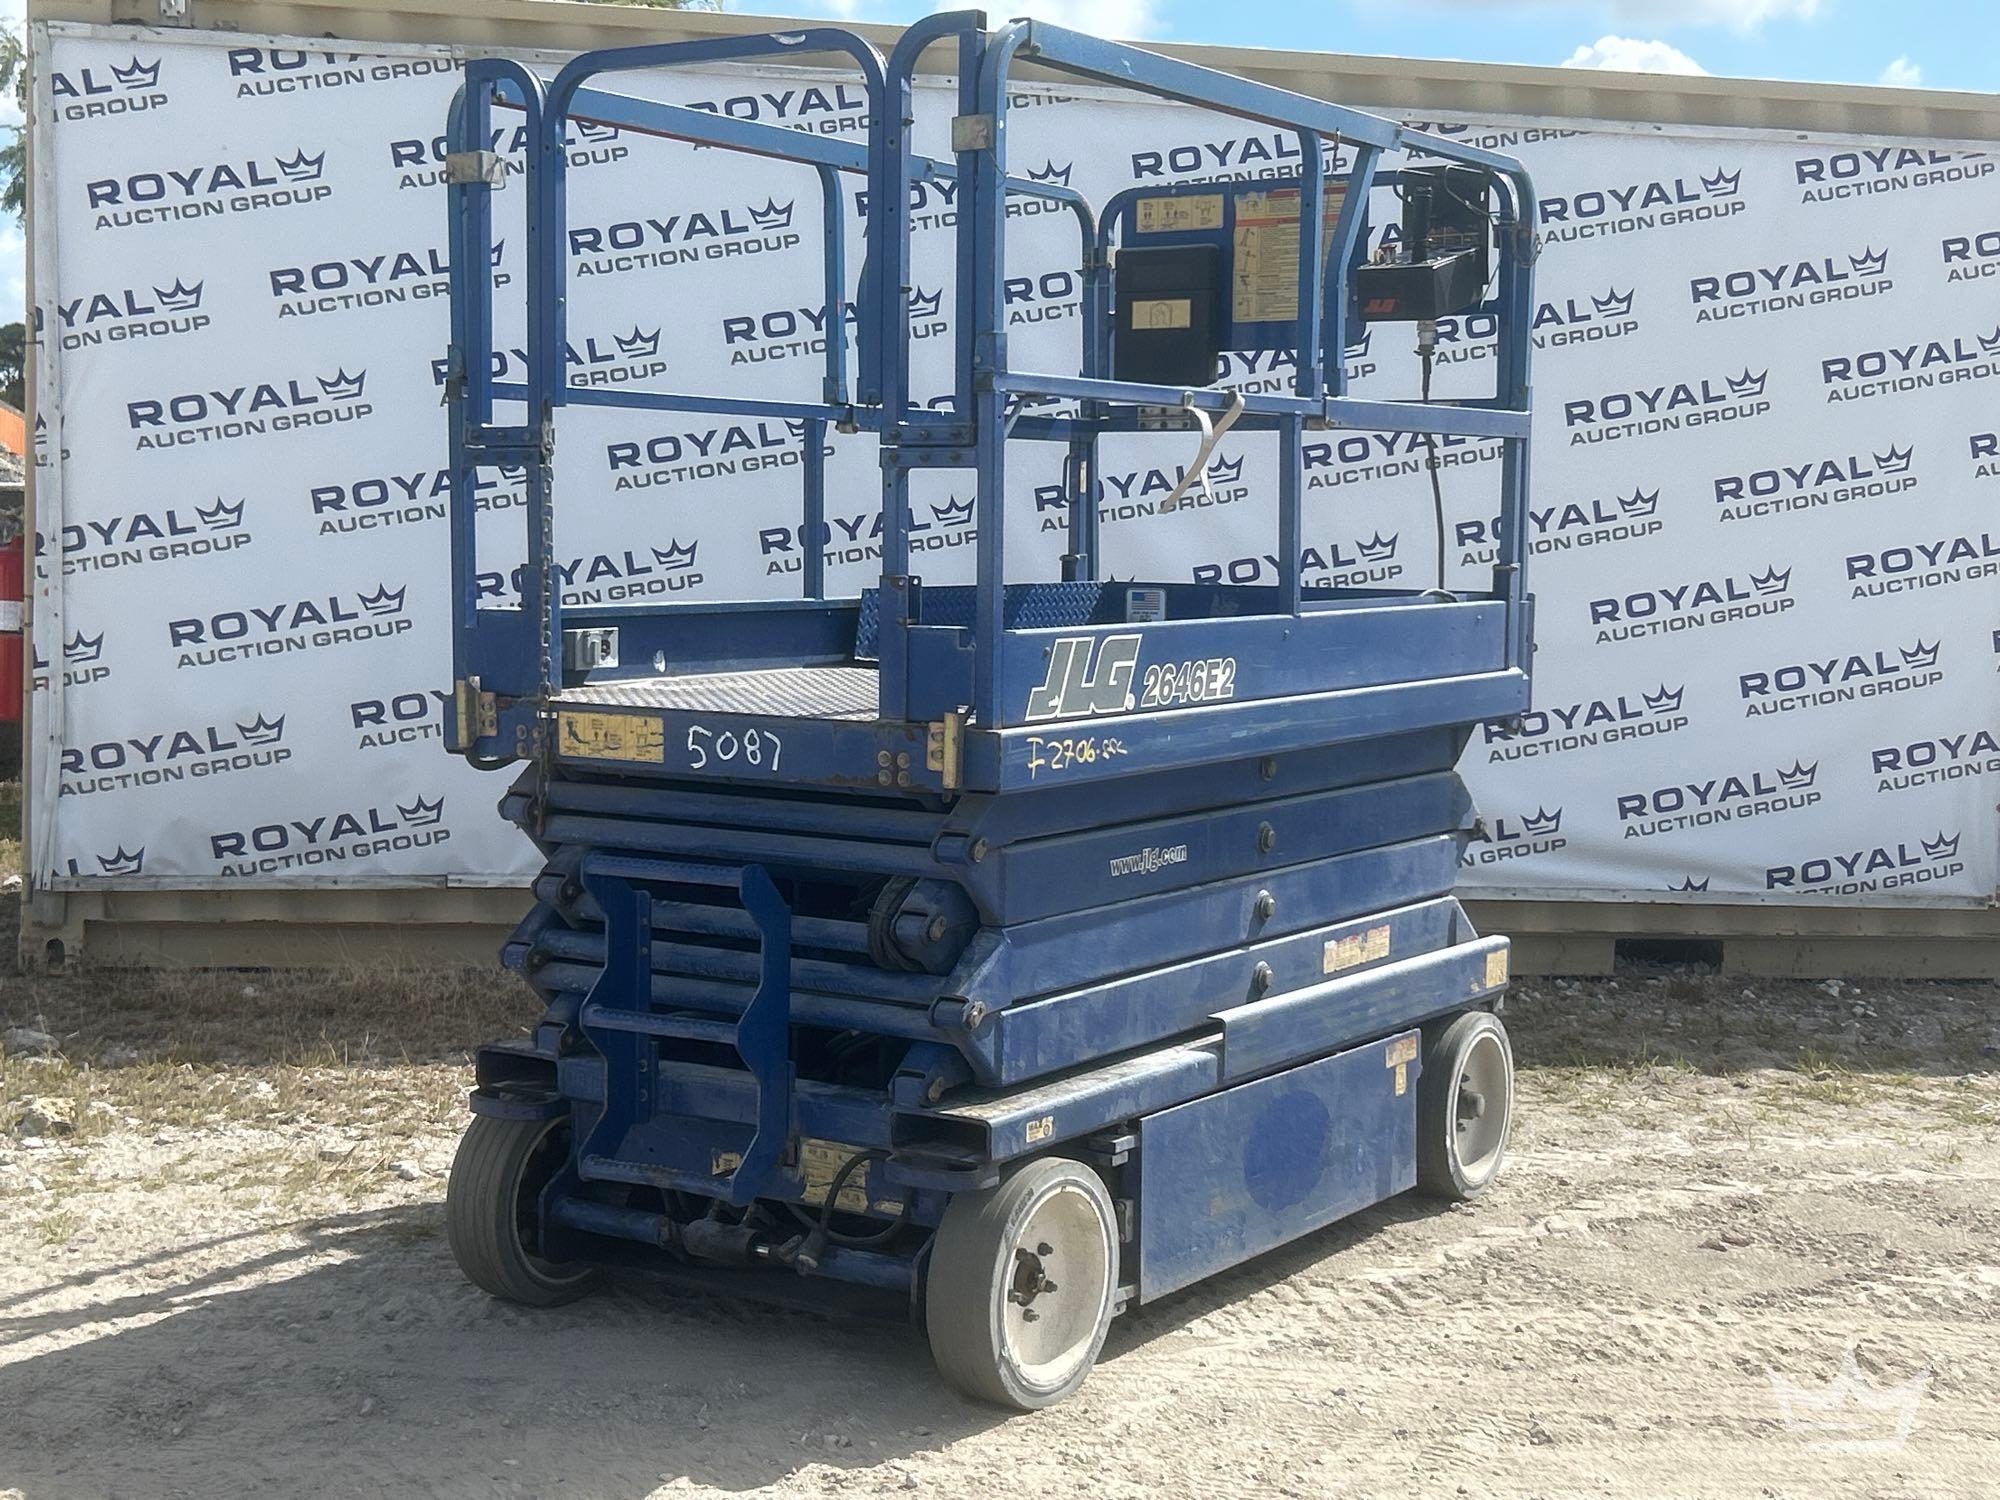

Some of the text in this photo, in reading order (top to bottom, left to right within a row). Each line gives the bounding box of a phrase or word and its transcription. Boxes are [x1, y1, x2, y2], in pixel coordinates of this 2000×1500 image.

[237, 69, 365, 98] AUCTION
[65, 94, 169, 121] GROUP
[566, 146, 631, 168] OUP
[1130, 134, 1302, 179] ROYAL
[1796, 141, 1952, 185] ROYAL
[85, 161, 278, 209] ROYAL
[1538, 179, 1701, 225] ROYAL
[1802, 163, 1995, 204] AUCTION GROUP
[94, 186, 332, 230] AUCTION GROUP
[1545, 201, 1746, 244] AUCTION GROUP
[569, 210, 750, 256] ROYAL
[577, 234, 800, 277] AUCTION GROUP
[270, 249, 454, 297] ROYAL
[279, 273, 511, 318] AUCTION GRP
[1690, 258, 1849, 304] ROYAL
[31, 290, 156, 329] YAL
[1429, 300, 1592, 346] ROAL
[1696, 280, 1893, 323] AUCTION GROUP
[108, 315, 211, 342] GROUP
[1435, 321, 1638, 366] AUCTN GROUP
[570, 362, 668, 388] GROUP
[730, 339, 828, 366] AUCTIO
[1822, 338, 1978, 384] ROYAL
[128, 380, 319, 430] ROYAL
[1565, 380, 1726, 427] ROYAL
[1828, 362, 2000, 403] AUCTION GROU
[137, 404, 373, 451] AUCTION GROUP
[607, 423, 786, 471] ROYAL
[1571, 401, 1771, 447] AUCTION GROUP
[615, 446, 836, 491] AUCTION GROP
[1031, 465, 1203, 513] RYAL
[1308, 459, 1420, 490] AUCTION
[1714, 457, 1873, 503] ROYAL
[320, 491, 530, 536] AUCTION ROU
[1720, 477, 1917, 523] AUCTION GROUP
[150, 533, 252, 561] GROUP
[765, 529, 979, 576] AUTION ROUP
[1461, 521, 1663, 567] AUION GROUP
[1846, 534, 2000, 581] ROYAL
[469, 551, 653, 601] RYAL
[608, 573, 705, 601] GROUP
[1316, 565, 1402, 591] GROUP
[1852, 569, 1961, 600] AUCTION
[169, 597, 359, 648] ROYAL
[1590, 578, 1750, 625] ROYAL
[1596, 598, 1795, 645] AUCTION GROUP
[178, 619, 413, 669] AUCTION GROUP
[1025, 634, 1236, 721] JLG 2646E2
[1740, 652, 1900, 699] ROYAL
[1746, 672, 1944, 718] AUCTION GROUP
[359, 723, 442, 750] AUCTI
[688, 725, 782, 771] 5087
[1489, 717, 1688, 764] AUCTION GROUP
[1872, 731, 2000, 774] ROYA
[55, 749, 291, 799] AUCTION GROUP
[1618, 773, 1777, 821] ROYAL
[1878, 762, 1982, 793] AUCTION
[211, 809, 398, 860] ROYAL
[1624, 792, 1821, 840] AUCTION GROUP
[220, 829, 451, 880] AUCTION GROUP
[1110, 845, 1187, 876] www.jlg.com
[1480, 837, 1566, 864] GROUP
[1767, 844, 1922, 891] ROYAL
[1882, 863, 1964, 889] GROUP
